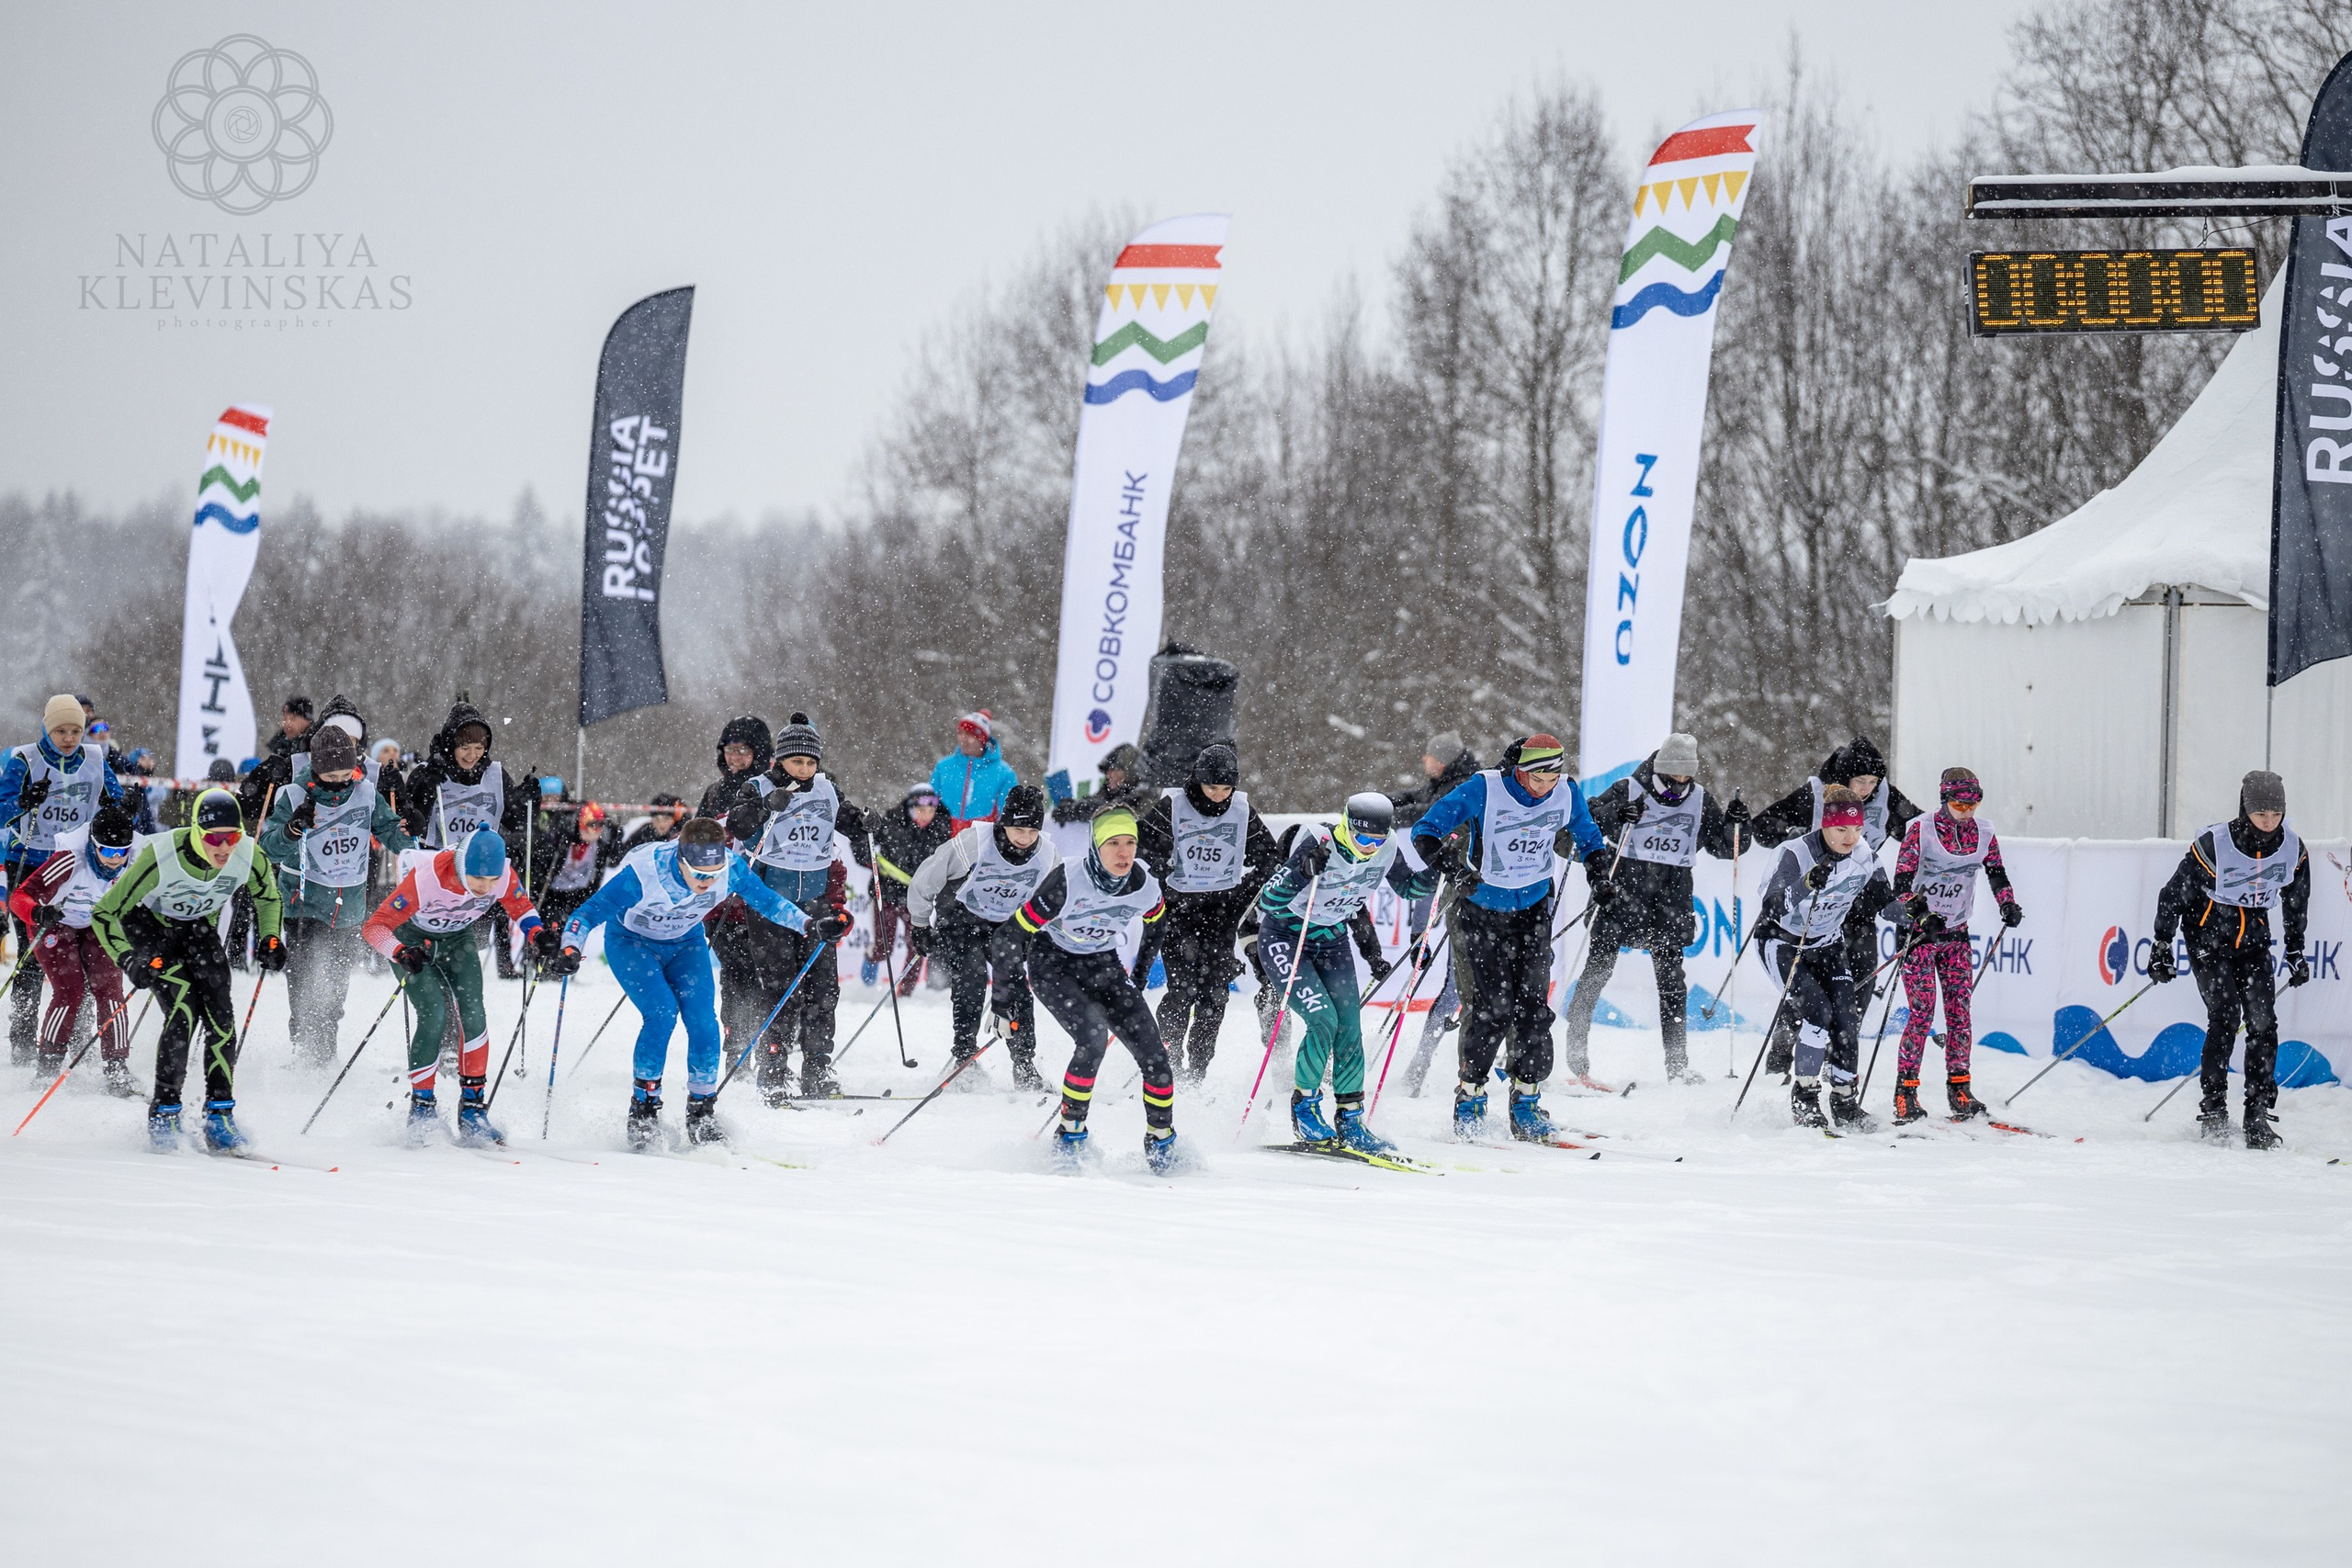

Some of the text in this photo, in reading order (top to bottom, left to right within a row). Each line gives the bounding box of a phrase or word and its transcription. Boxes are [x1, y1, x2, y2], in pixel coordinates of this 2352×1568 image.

[602, 414, 641, 598] RUSSIA
[1615, 453, 1658, 665] OZON
[1092, 469, 1148, 704] СОВКОМБАНК
[42, 806, 79, 822] 6156
[322, 836, 359, 856] 6159
[1644, 836, 1681, 852] 6163
[1186, 845, 1222, 862] 6135
[1928, 883, 1962, 897] 6149
[1323, 896, 1367, 908] 6145
[1295, 987, 1329, 1013] ski
